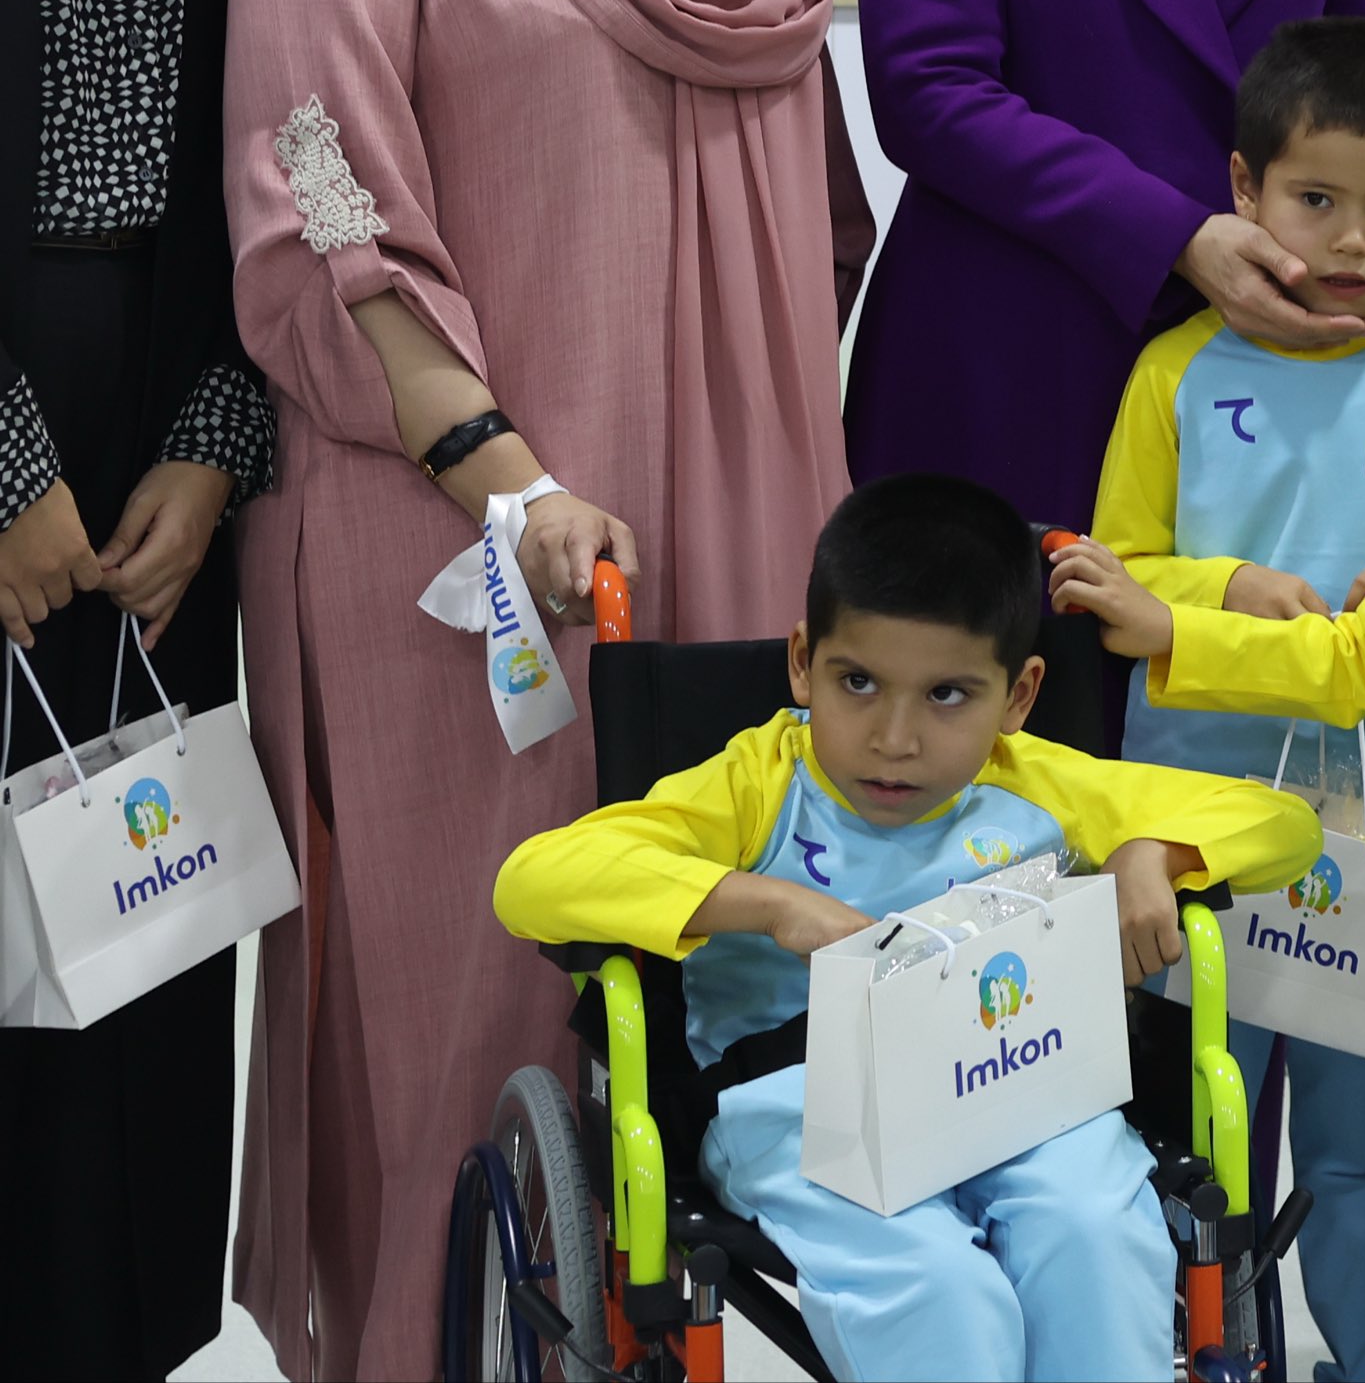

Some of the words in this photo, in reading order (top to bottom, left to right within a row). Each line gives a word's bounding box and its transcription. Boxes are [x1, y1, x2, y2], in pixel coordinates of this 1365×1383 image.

[112, 842, 219, 915] Imkon
[1246, 913, 1360, 975] Imkon
[954, 1026, 1065, 1099] Imkon
